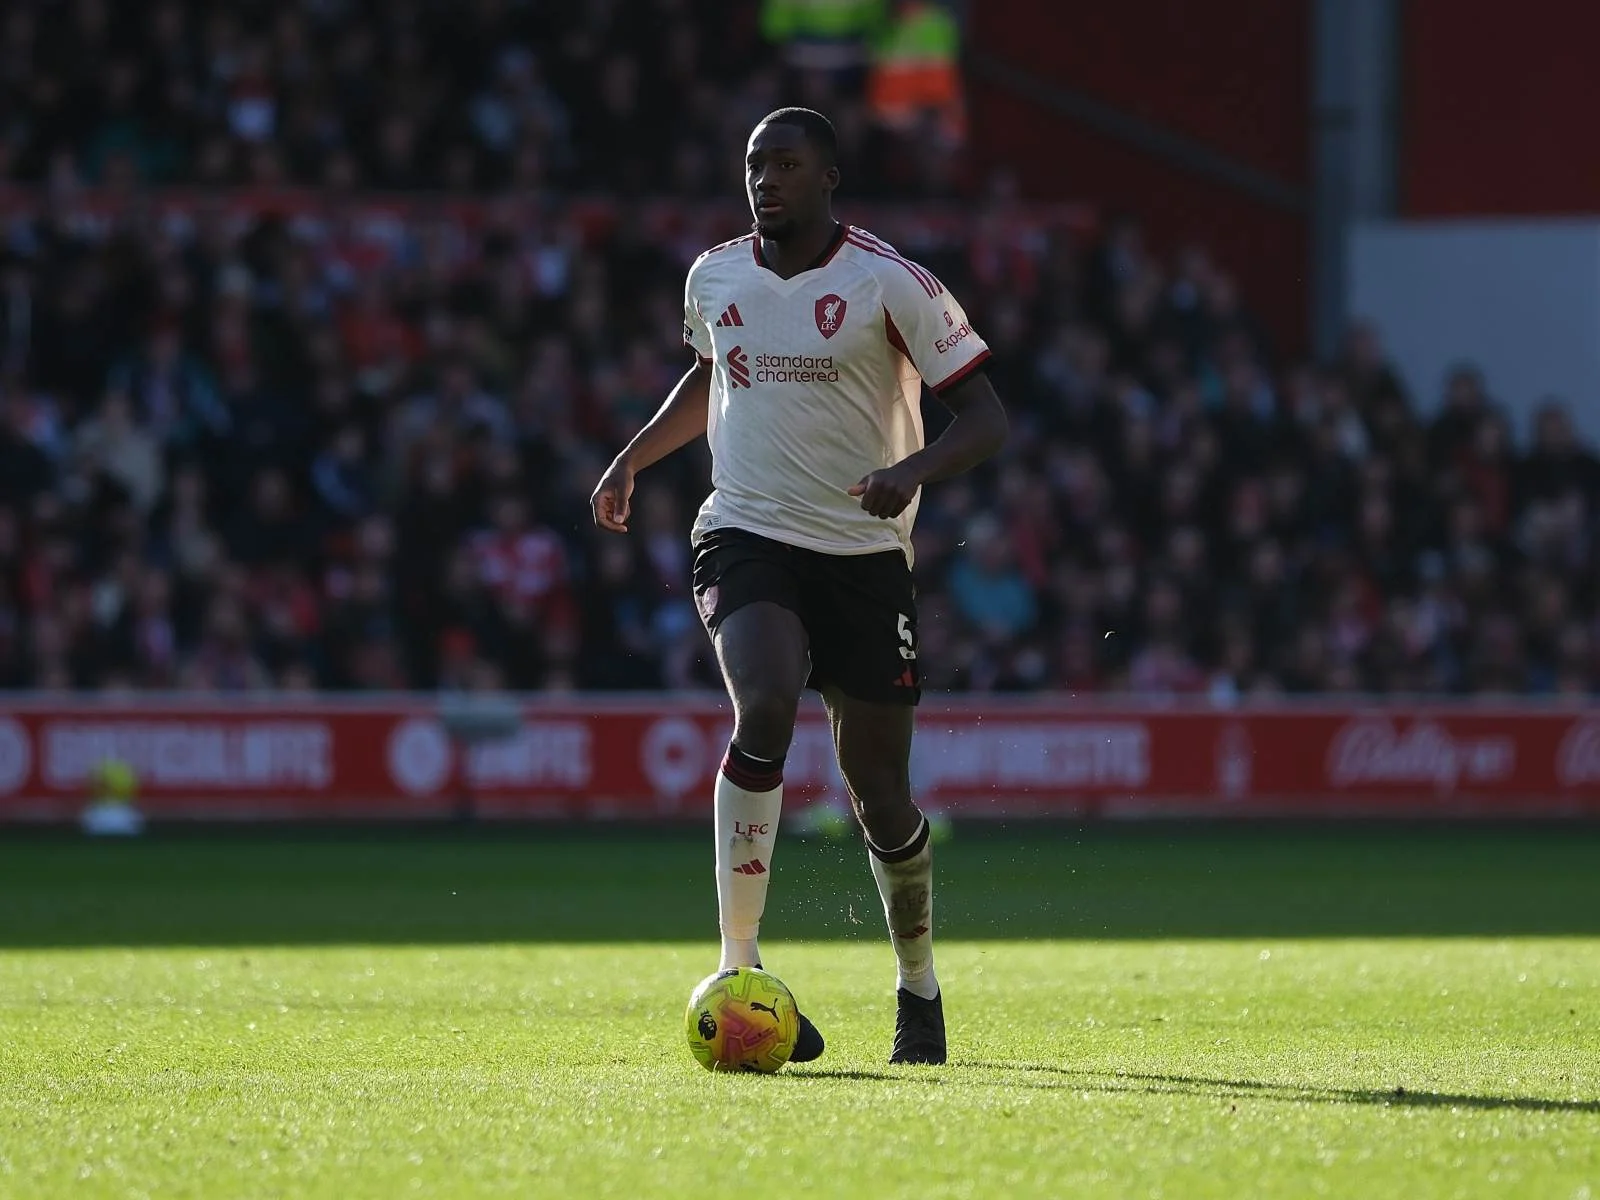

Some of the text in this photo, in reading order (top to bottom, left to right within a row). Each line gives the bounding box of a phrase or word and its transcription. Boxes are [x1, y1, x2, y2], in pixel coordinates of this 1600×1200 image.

[755, 353, 833, 369] standard
[756, 368, 839, 383] chartered
[897, 612, 917, 660] 5
[734, 821, 769, 837] LFC
